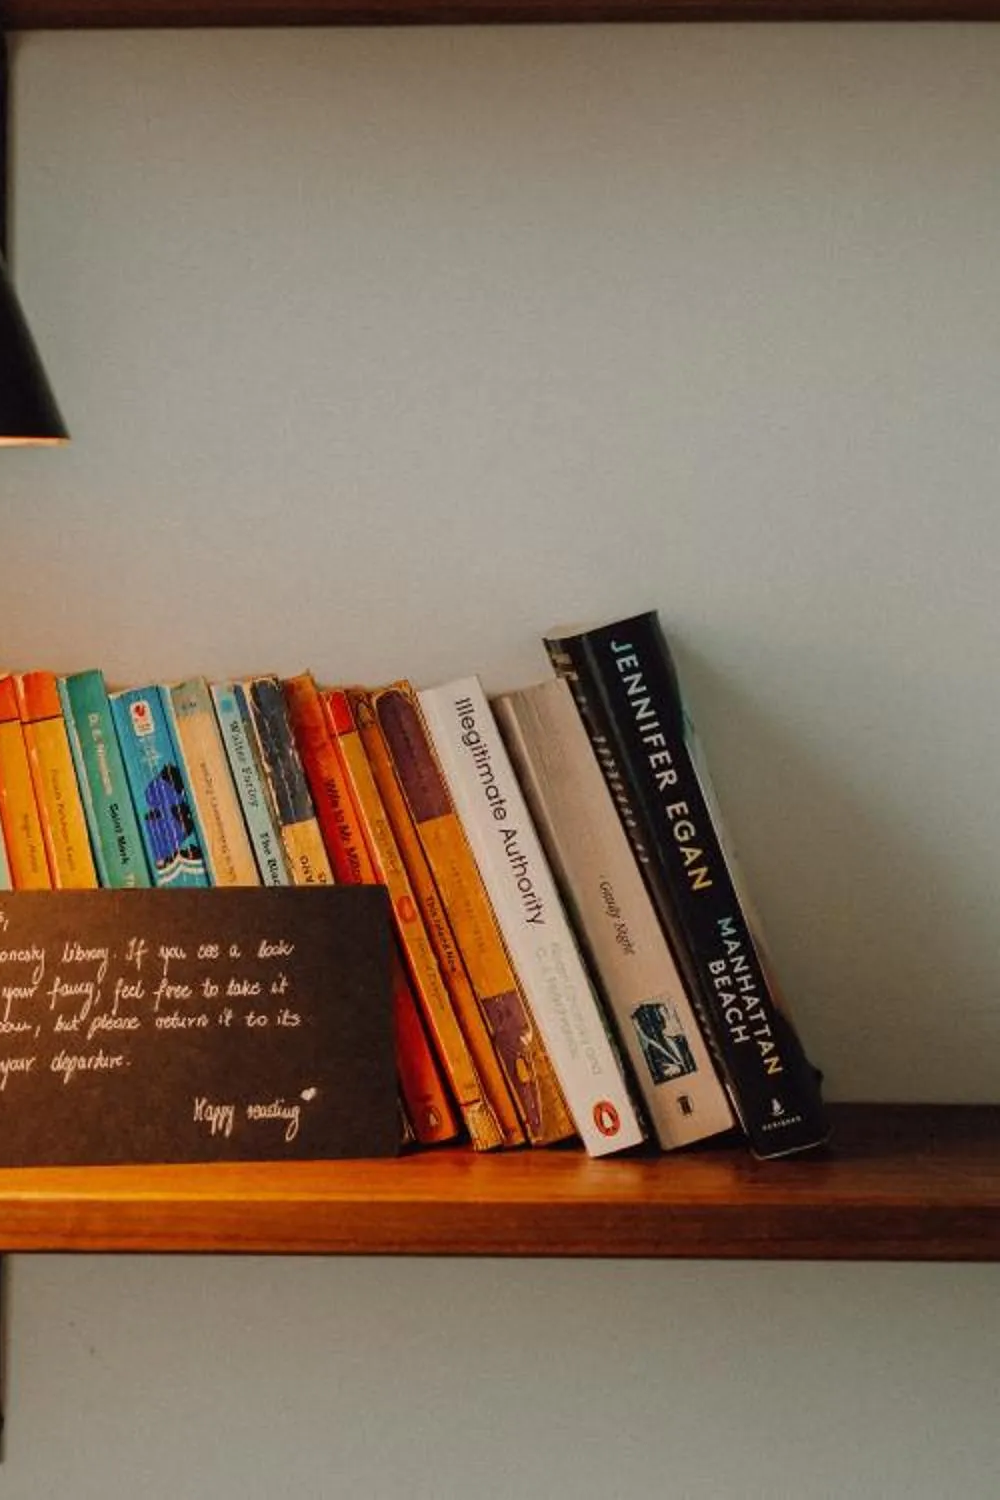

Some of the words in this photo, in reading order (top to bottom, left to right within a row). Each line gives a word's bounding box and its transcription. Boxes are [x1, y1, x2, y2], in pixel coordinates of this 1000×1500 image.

[229, 721, 248, 763] Walter
[241, 766, 260, 809] Farley
[609, 640, 679, 792] JENNIFER
[665, 800, 713, 892] EGAN
[455, 696, 510, 822] Illegitimate
[498, 827, 546, 926] Authority
[259, 831, 275, 855] The
[265, 859, 282, 887] Blac
[124, 936, 149, 970] If
[157, 945, 187, 977] you
[229, 944, 241, 959] a
[2, 988, 38, 1021] your
[111, 977, 145, 1015] feel
[152, 977, 193, 1012] free
[200, 983, 219, 999] to
[226, 979, 262, 998] take
[270, 971, 288, 995] it
[708, 960, 752, 1044] BEACH
[717, 916, 784, 1075] MANHATTAN
[53, 1014, 80, 1033] but
[86, 1013, 141, 1041] please
[155, 1011, 209, 1030] return
[218, 1007, 234, 1027] it
[246, 1011, 268, 1027] to
[277, 1007, 301, 1027] its
[50, 1049, 132, 1084] departure.
[193, 1097, 235, 1138] Happy
[246, 1098, 301, 1141] reading
